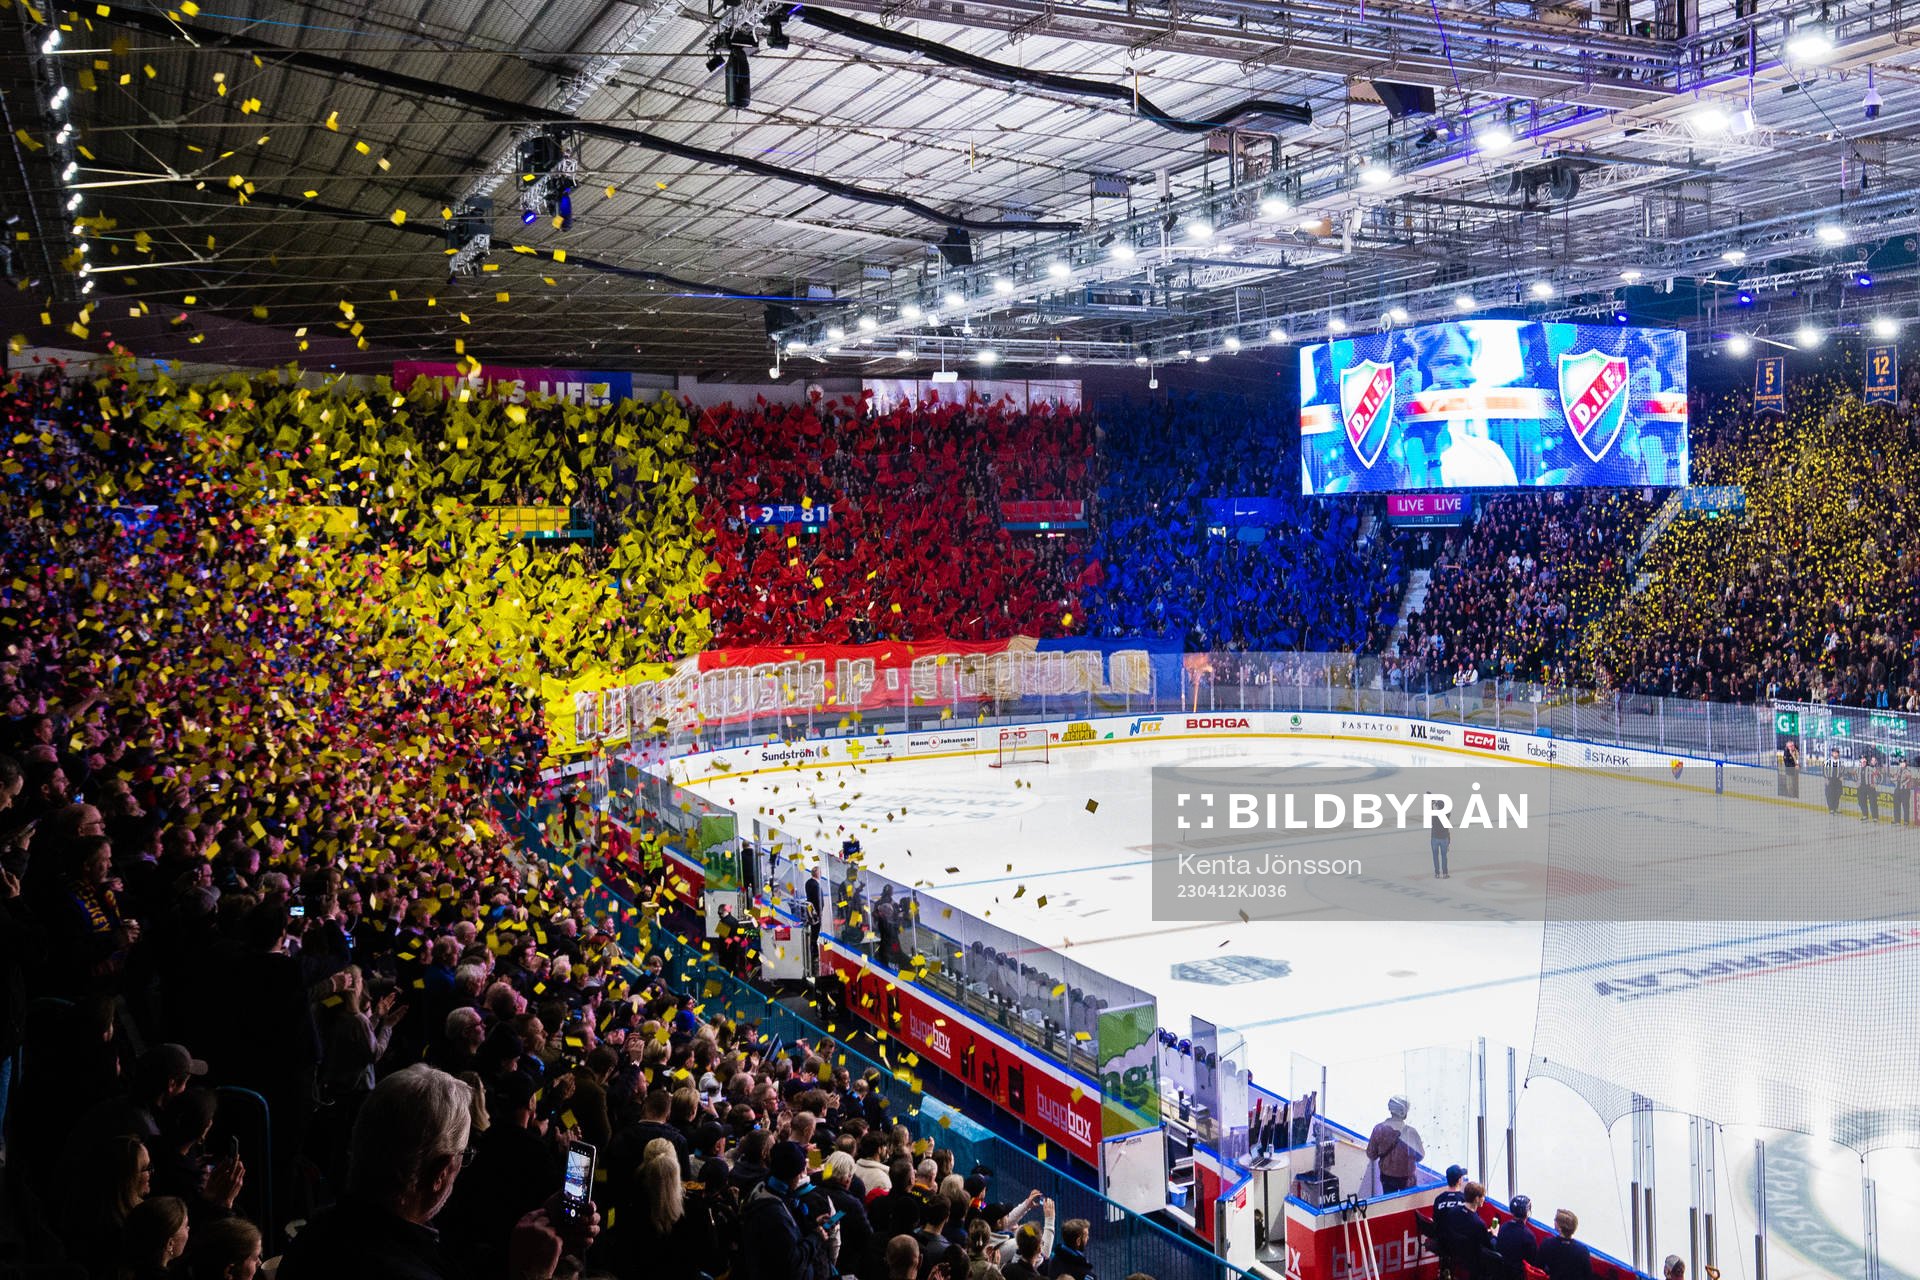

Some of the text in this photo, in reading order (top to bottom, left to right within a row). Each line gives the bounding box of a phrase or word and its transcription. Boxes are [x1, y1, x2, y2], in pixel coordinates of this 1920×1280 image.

[1873, 355, 1890, 375] 12
[1765, 367, 1774, 385] 5
[1398, 498, 1461, 511] LIVE LIVE
[1186, 718, 1250, 729] BORGA
[1410, 724, 1428, 739] XXL
[1465, 735, 1495, 747] CCM
[761, 748, 815, 762] Sundström
[1527, 743, 1557, 761] Fabege
[1591, 752, 1629, 766] STARK
[1036, 1085, 1092, 1142] byggbox
